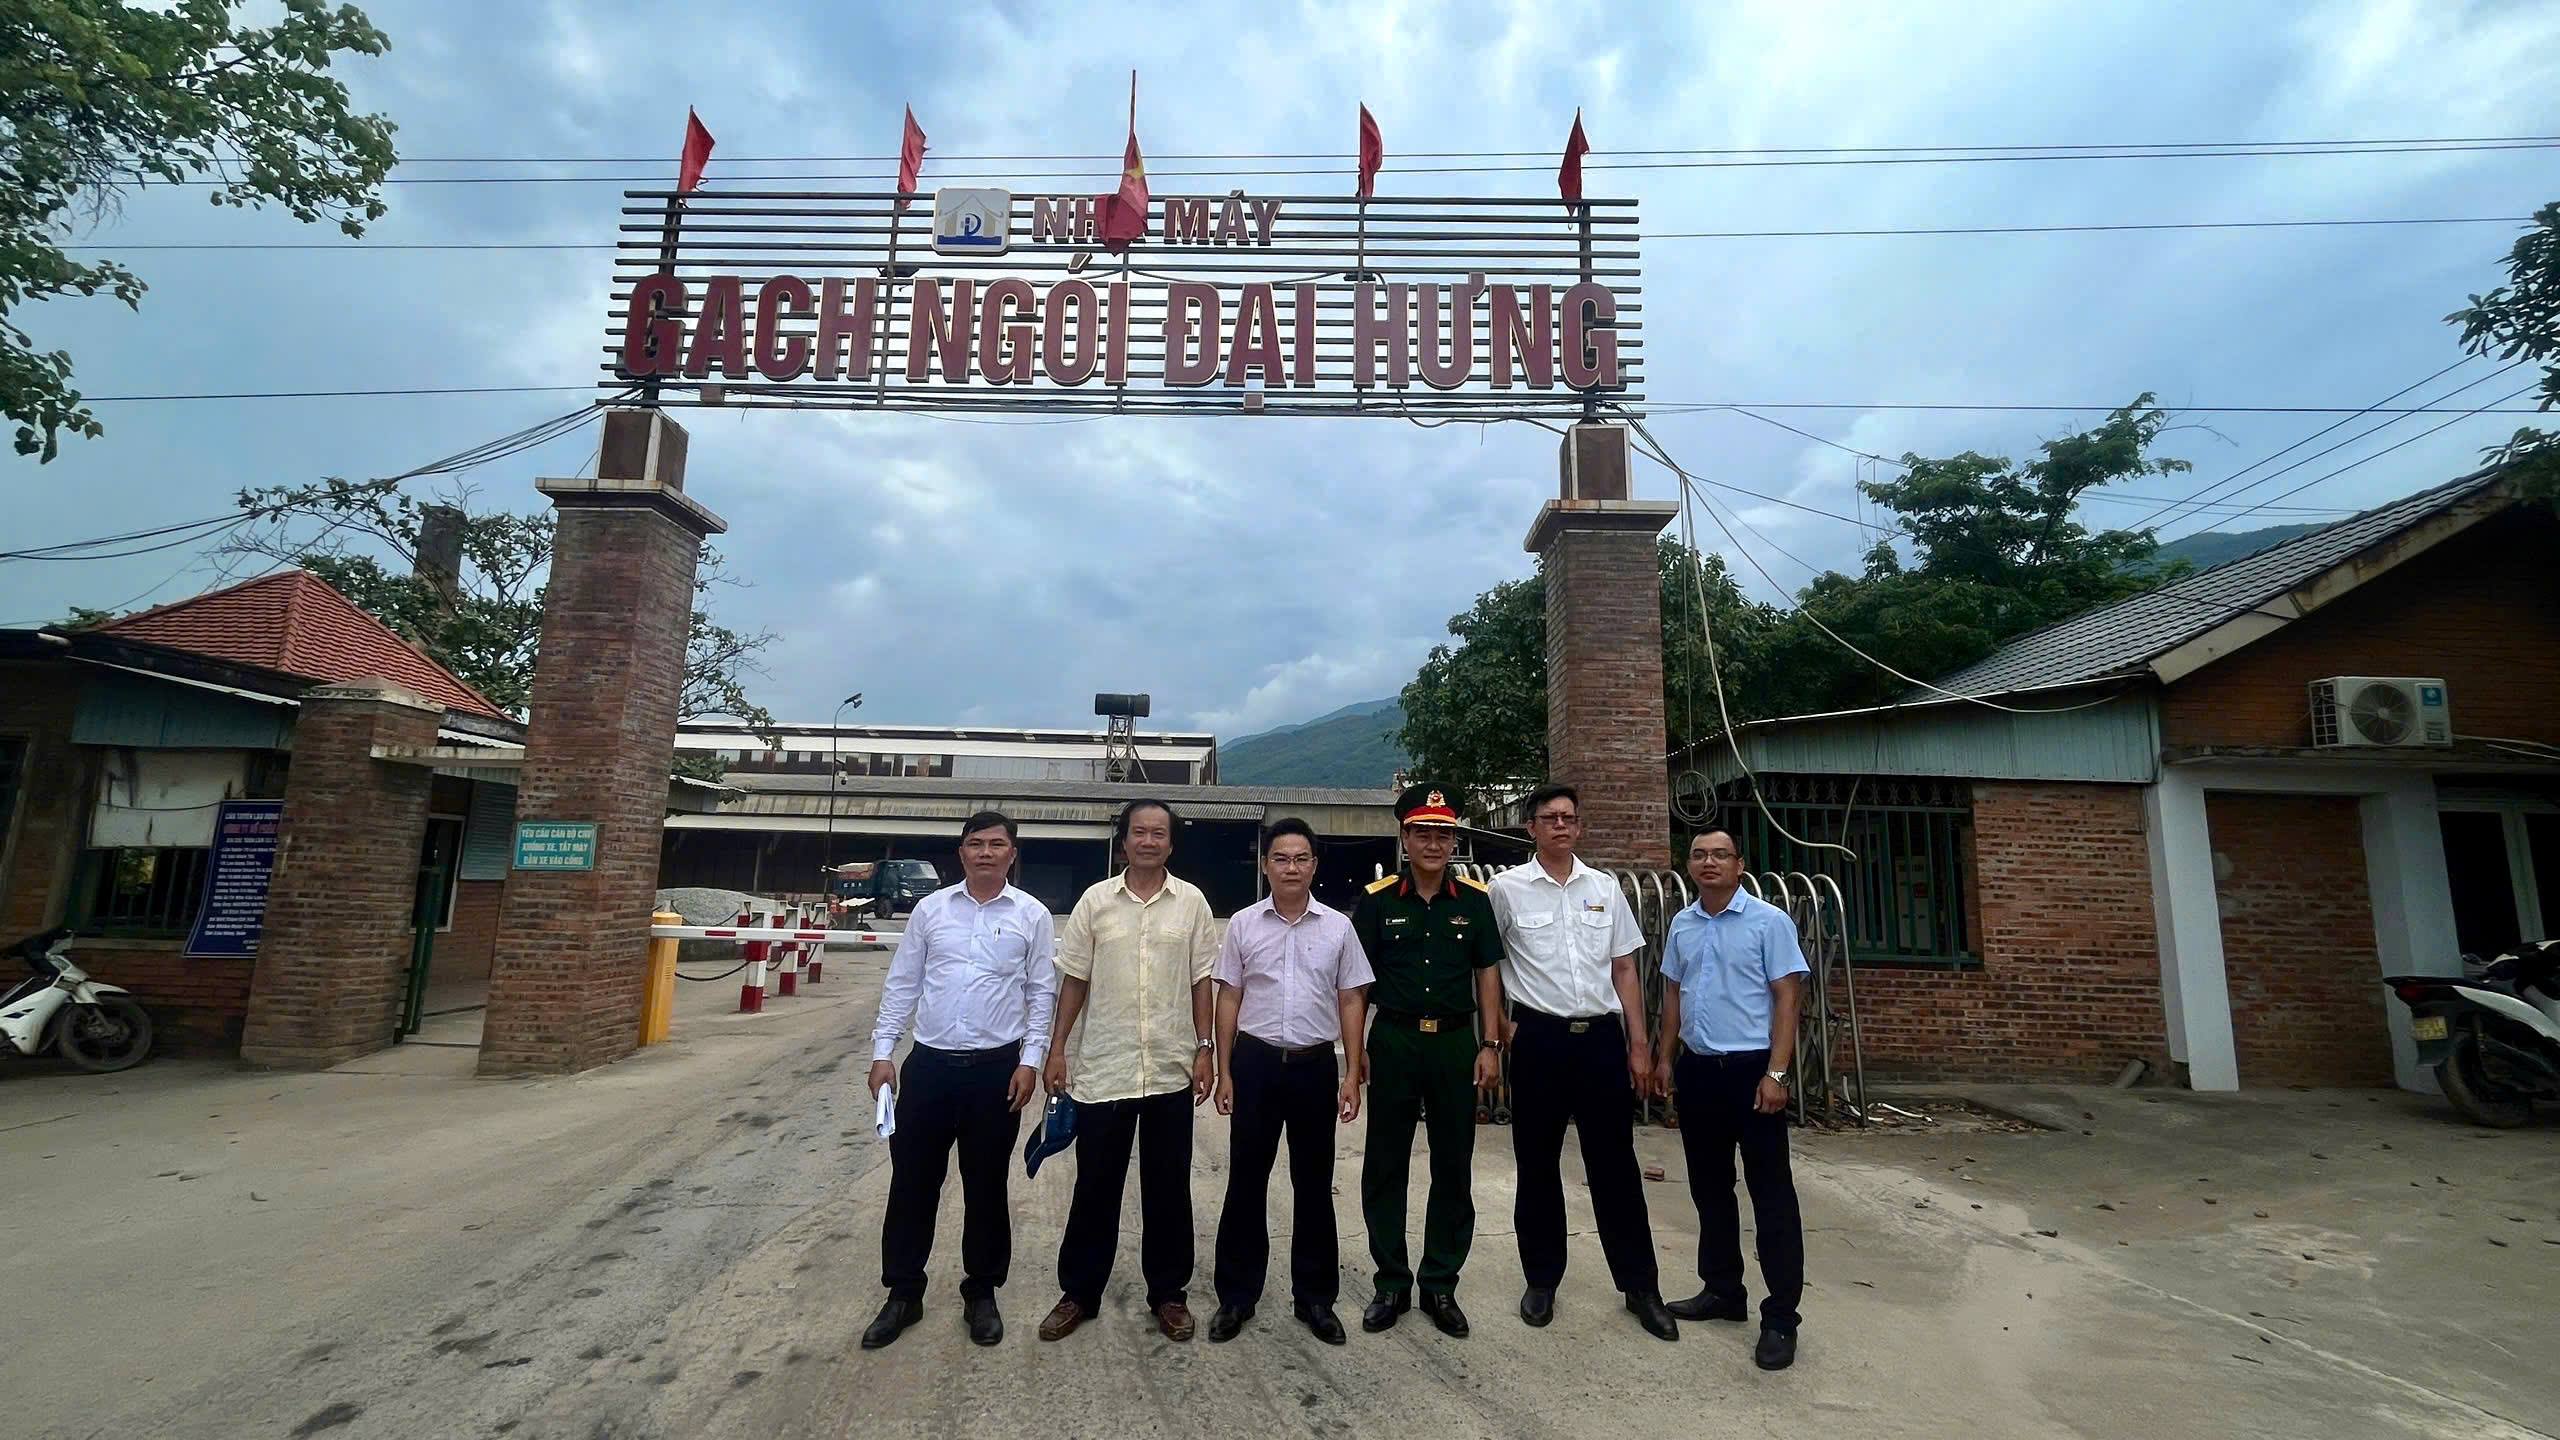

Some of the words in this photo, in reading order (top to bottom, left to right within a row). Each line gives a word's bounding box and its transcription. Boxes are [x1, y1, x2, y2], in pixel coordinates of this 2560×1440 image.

[1032, 197, 1147, 244] NH
[1163, 189, 1282, 246] MÁY
[623, 272, 878, 405] GẠCH
[905, 253, 1132, 386] NGÓI
[1162, 280, 1317, 412] ĐẠI
[1353, 270, 1622, 392] HƯNG
